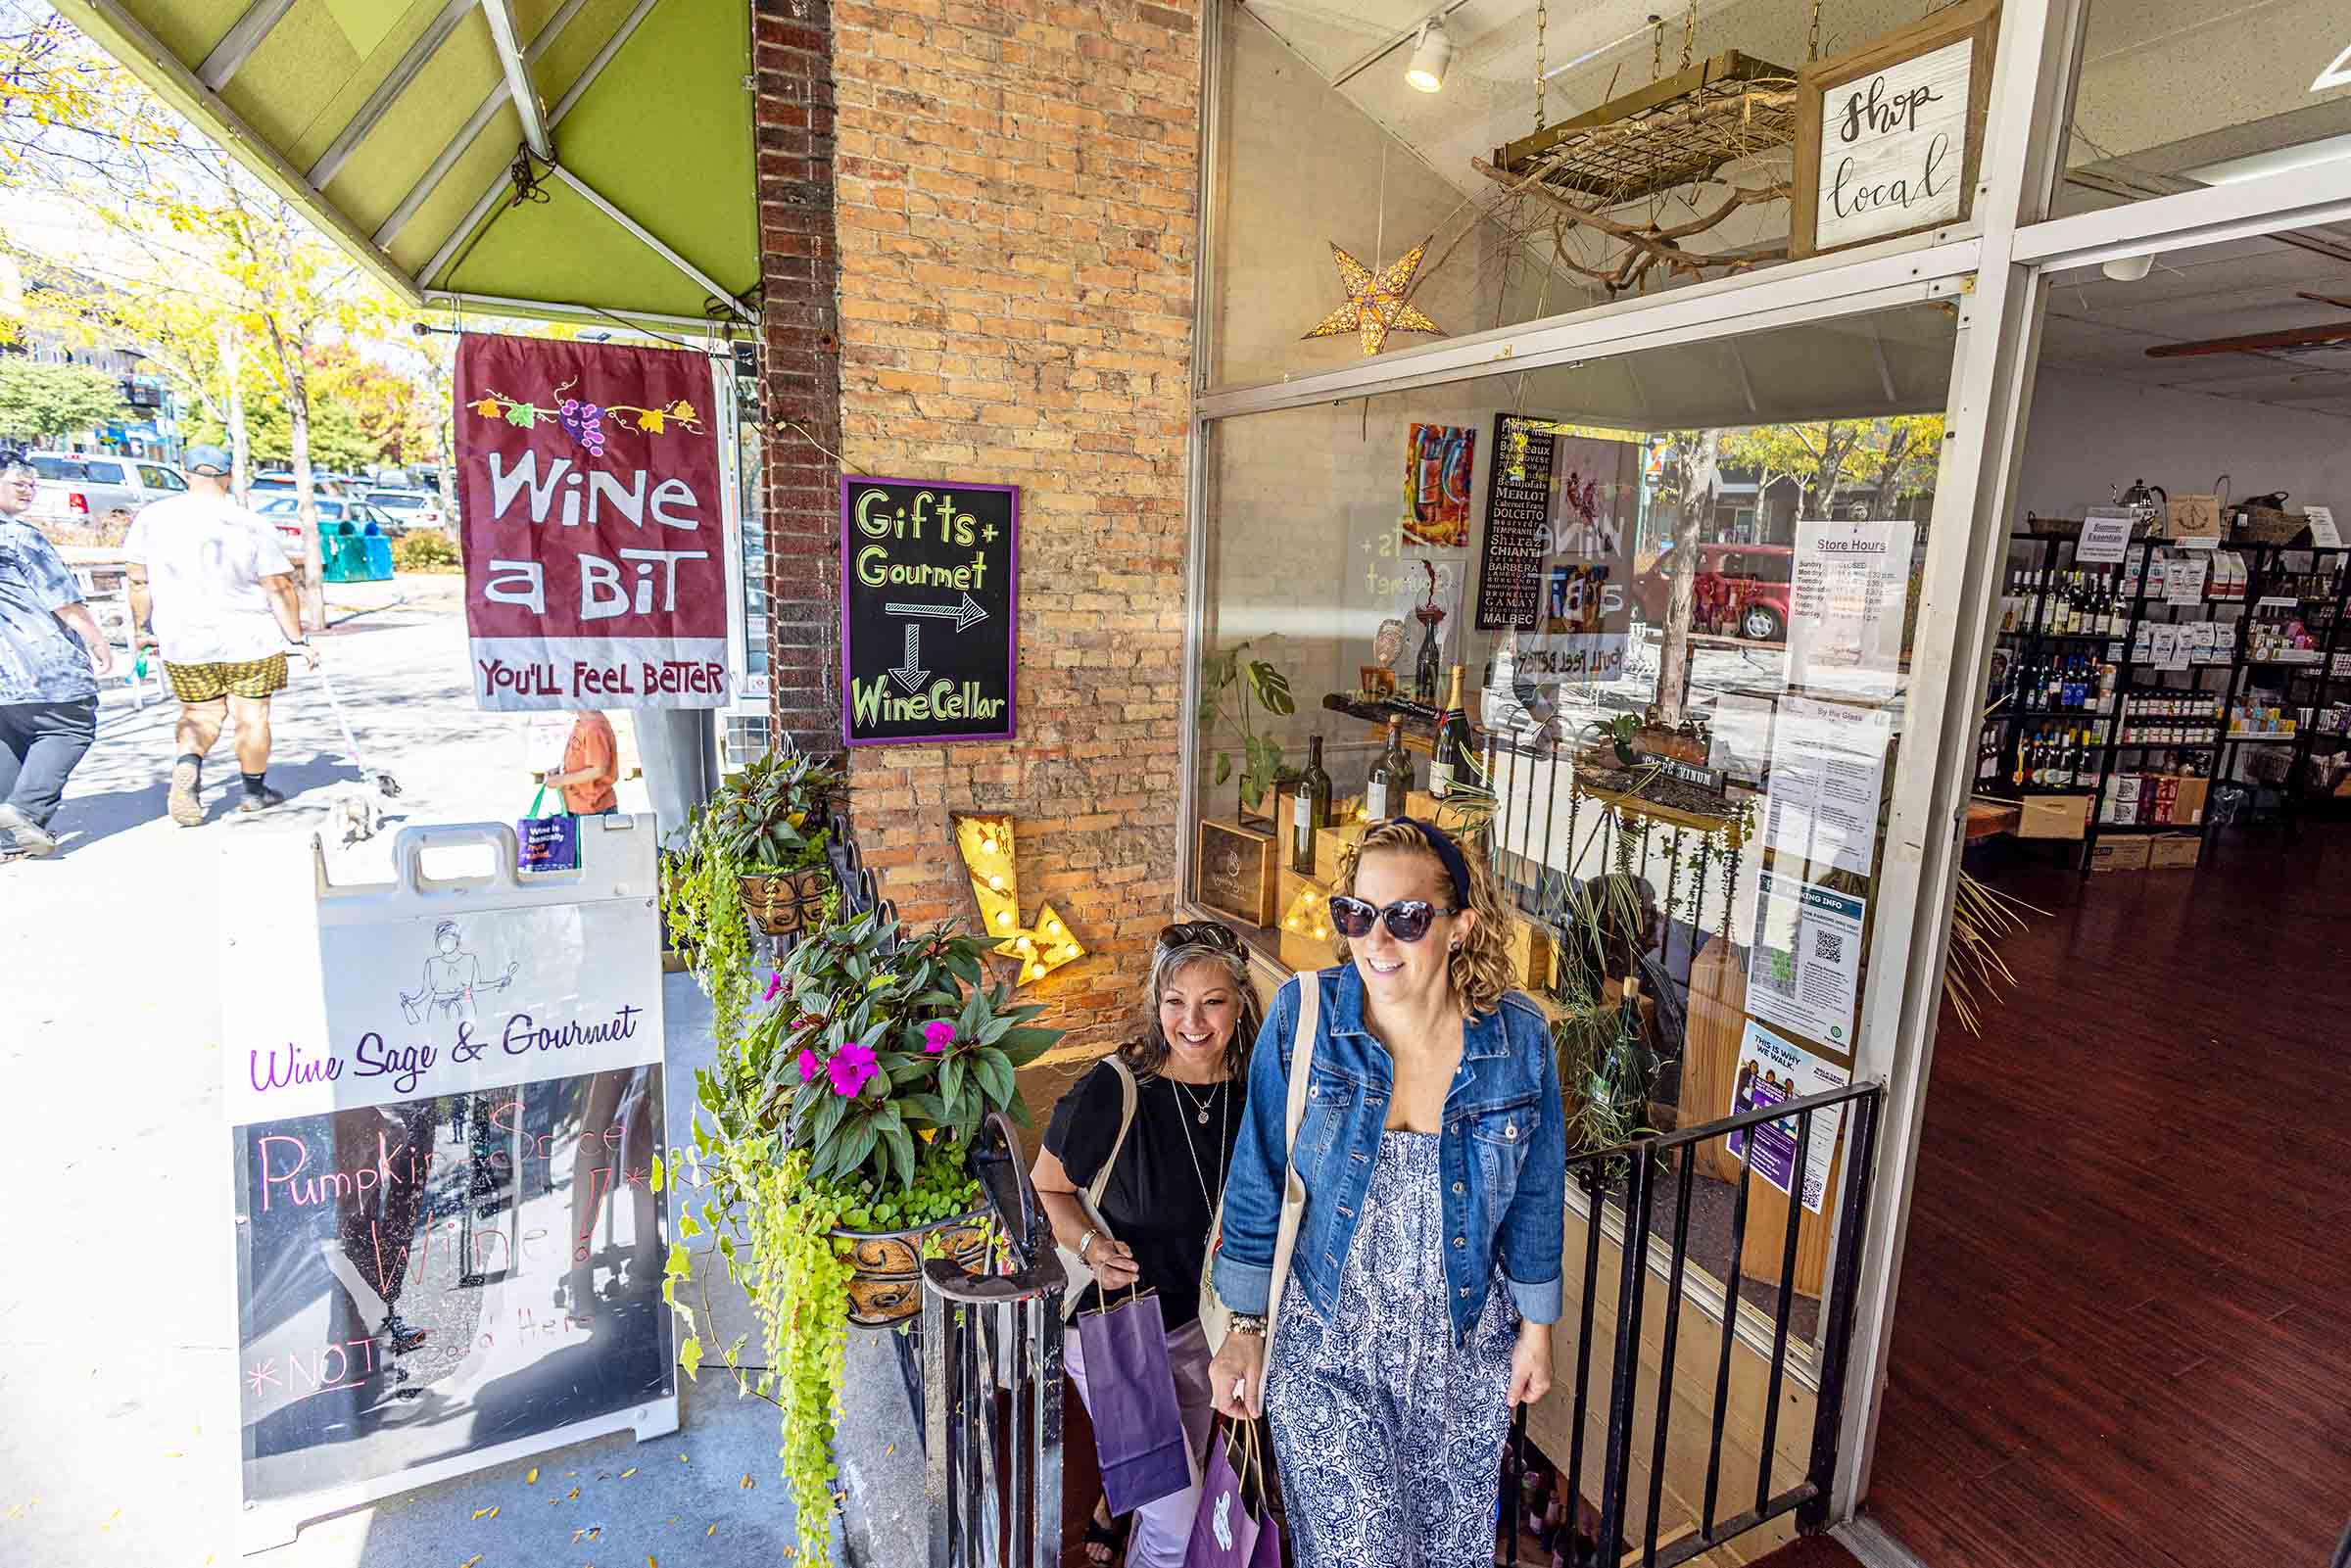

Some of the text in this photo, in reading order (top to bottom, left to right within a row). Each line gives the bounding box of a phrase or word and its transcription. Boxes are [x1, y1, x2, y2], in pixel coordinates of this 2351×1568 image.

[1827, 132, 1956, 219] local
[1496, 487, 1547, 501] MERLOT
[1493, 507, 1545, 521] DOLCETTO
[1490, 534, 1542, 547] Shiraz
[1817, 539, 1887, 550] Store Hours
[1490, 546, 1541, 557] CHIANTI
[855, 544, 987, 592] Gourmet
[1488, 562, 1538, 573] BARBERA
[485, 559, 547, 615] a
[1485, 590, 1536, 599] BRUNELLO
[1484, 597, 1536, 607] GAMAY
[1483, 613, 1534, 625] MALBEC
[1817, 707, 1828, 717] By
[1676, 767, 1712, 786] VINUM
[1822, 897, 1843, 910] INFO
[250, 1004, 644, 1094] Wine Sage & Gourmet
[1754, 1033, 1801, 1066] THIS IS WHY
[1756, 1043, 1770, 1058] WE
